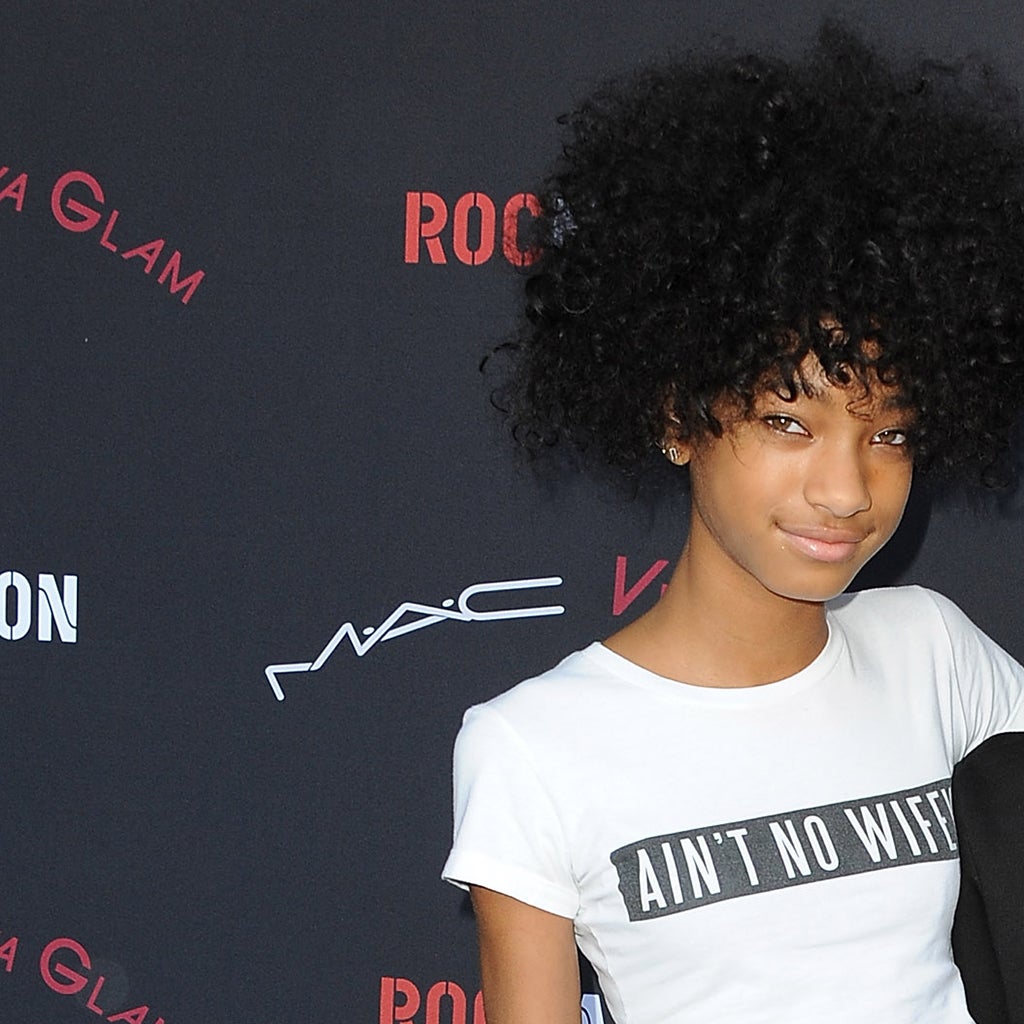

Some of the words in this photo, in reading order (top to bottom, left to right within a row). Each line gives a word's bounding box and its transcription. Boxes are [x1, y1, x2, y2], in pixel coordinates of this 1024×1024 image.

[51, 170, 205, 305] GLAM
[636, 827, 760, 913] AIN'T
[768, 814, 840, 881] NO
